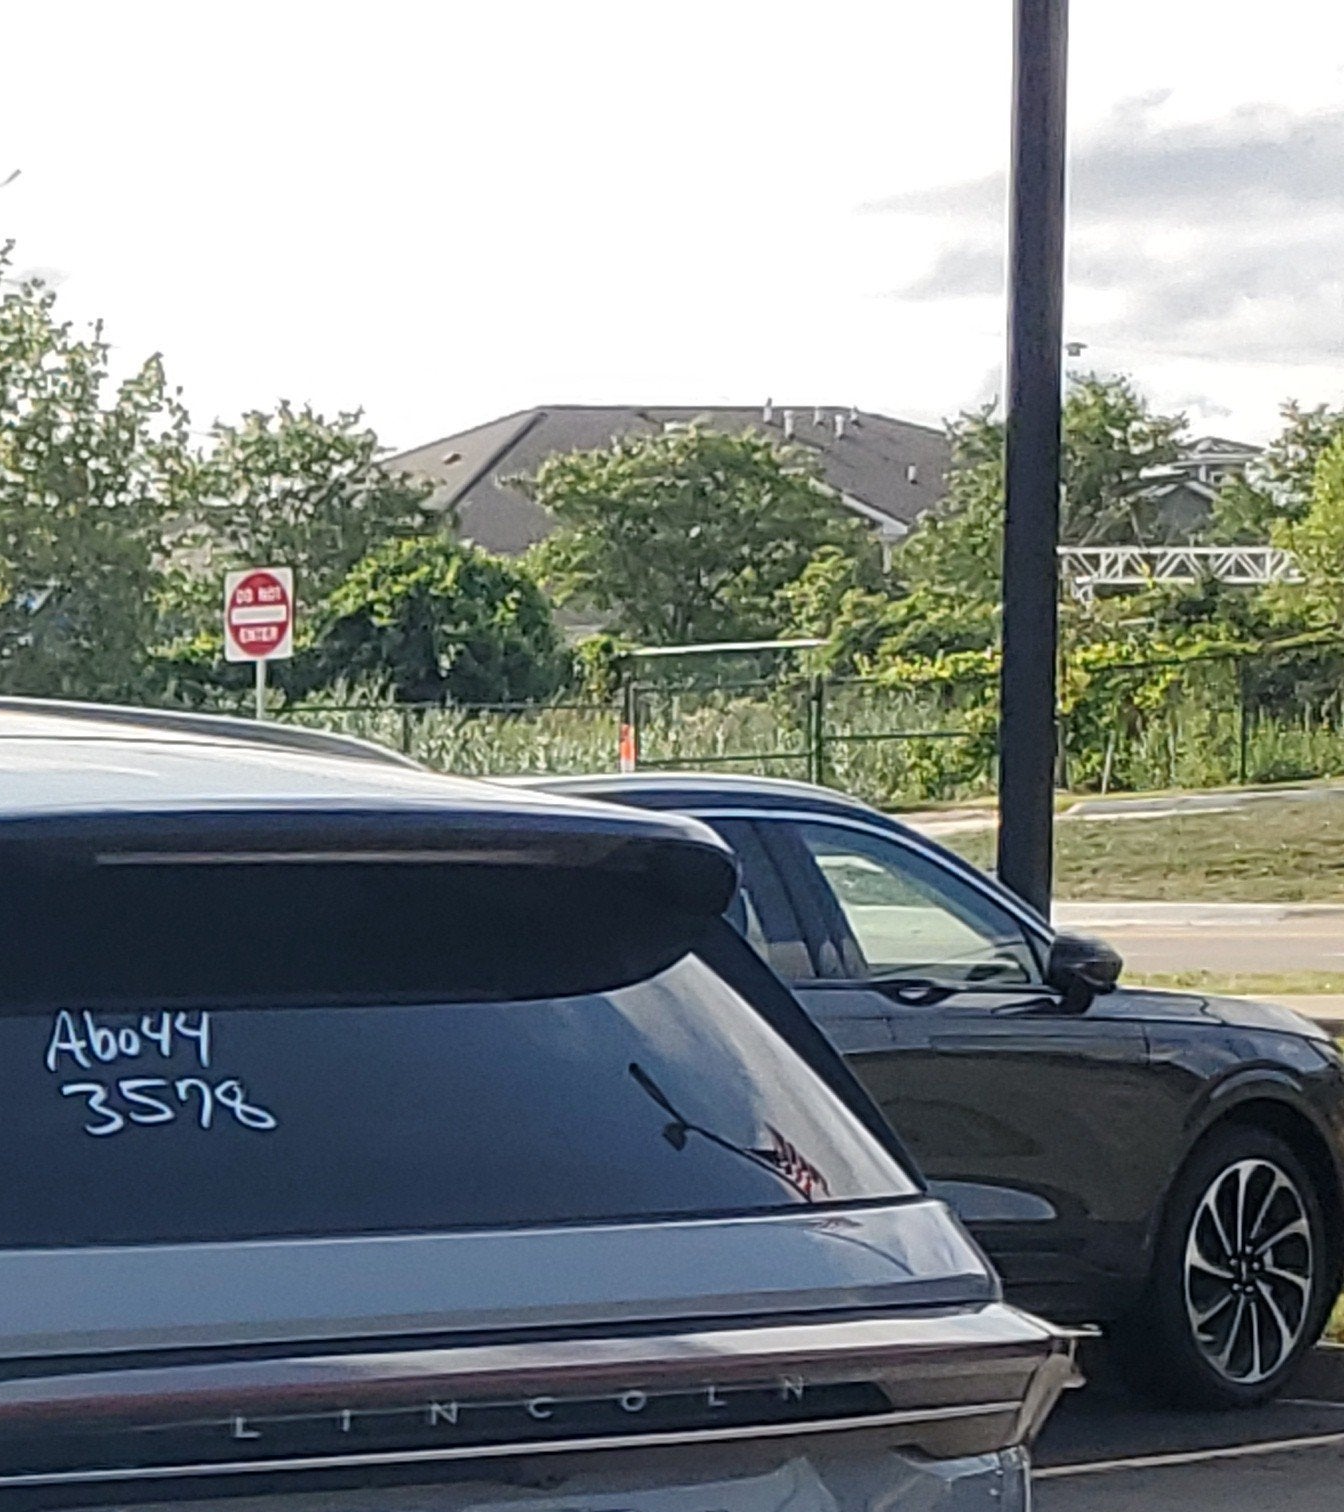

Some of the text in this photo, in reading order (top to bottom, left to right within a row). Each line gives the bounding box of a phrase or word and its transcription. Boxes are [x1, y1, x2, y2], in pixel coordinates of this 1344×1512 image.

[236, 585, 281, 604] DO NOT
[239, 626, 279, 643] ENTER
[62, 1078, 278, 1136] 3578
[232, 1375, 806, 1439] LINCOLN
